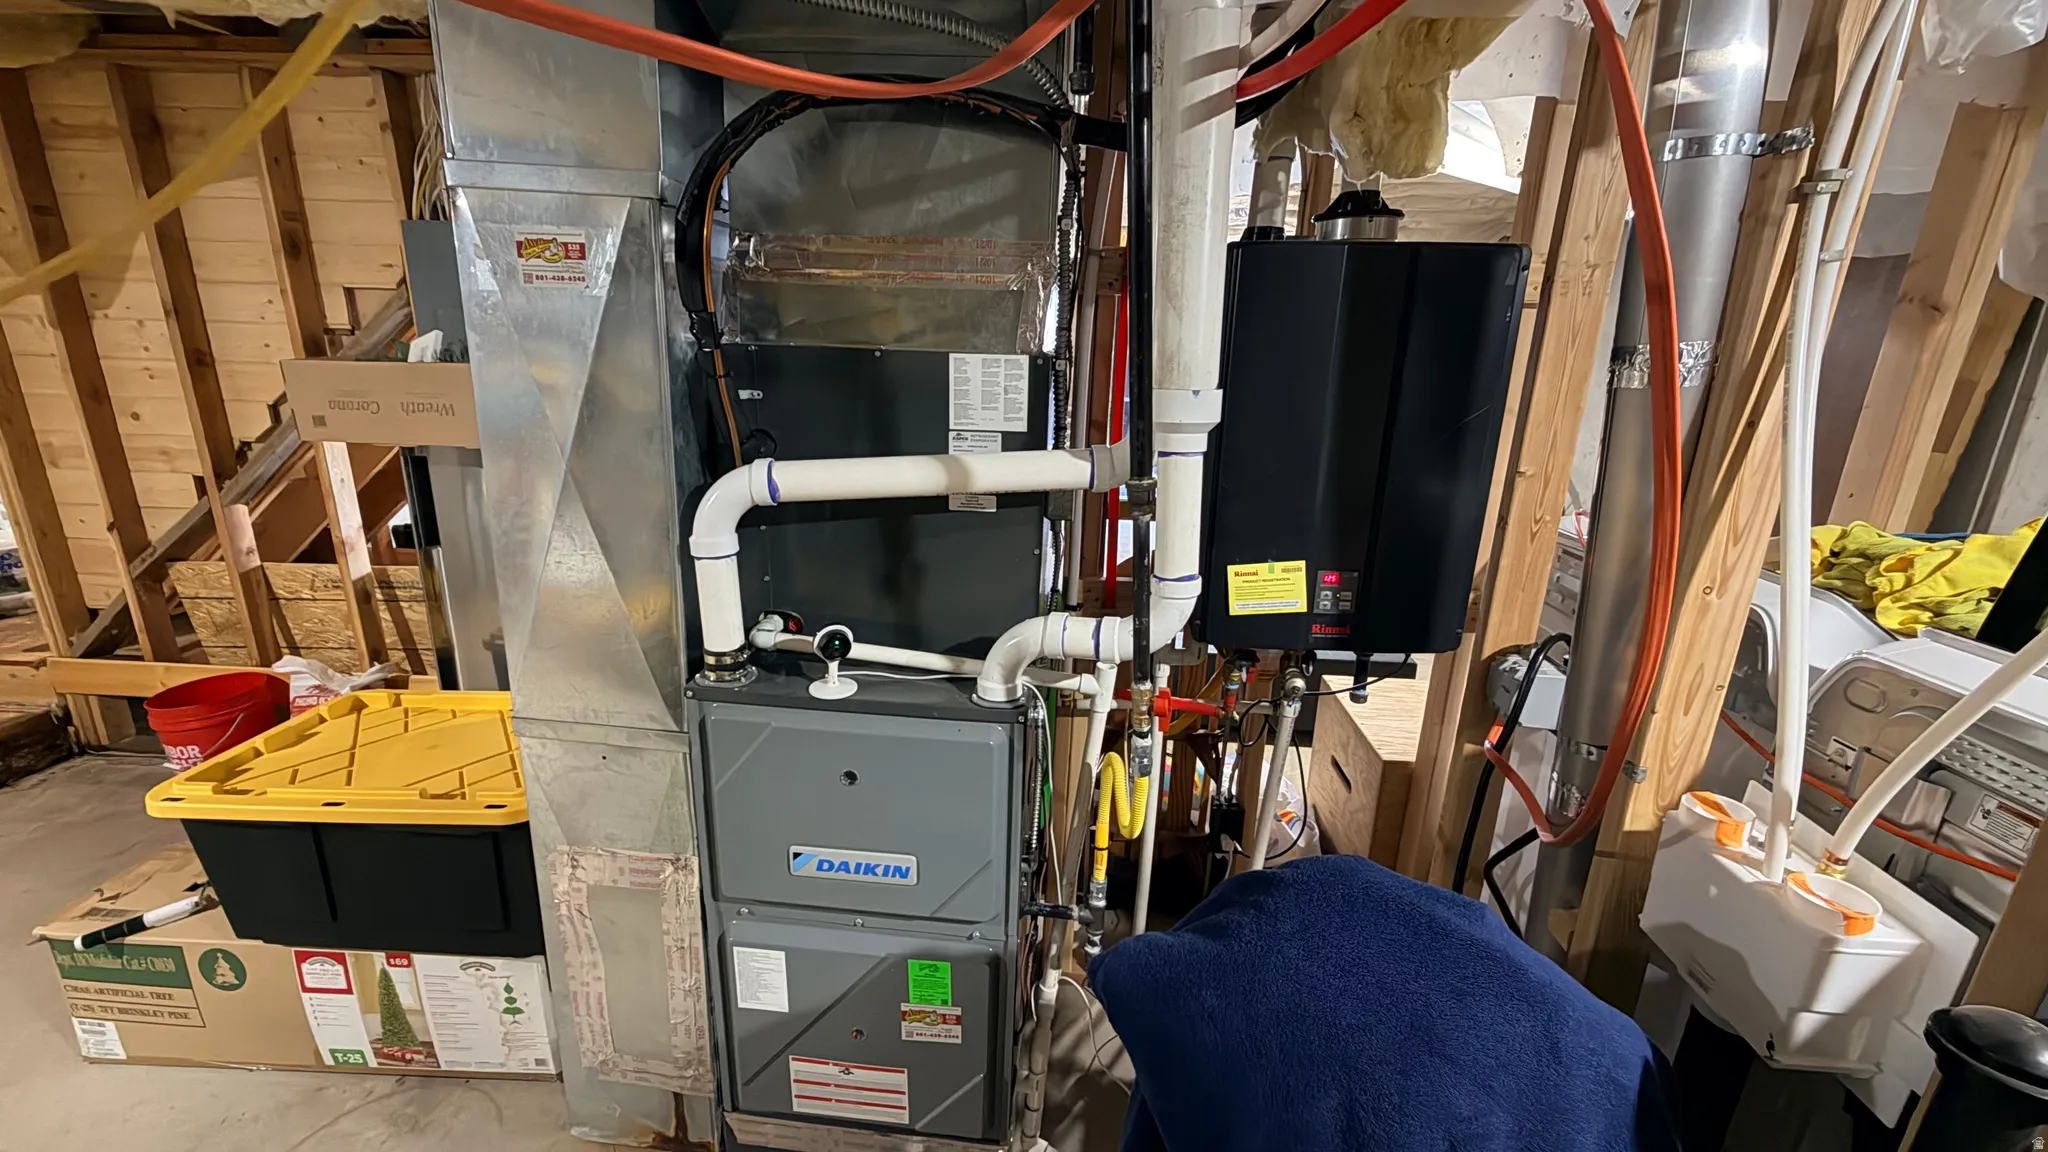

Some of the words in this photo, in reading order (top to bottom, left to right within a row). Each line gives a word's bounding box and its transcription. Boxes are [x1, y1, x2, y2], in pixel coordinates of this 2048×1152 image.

[328, 400, 380, 414] Corona
[400, 401, 455, 416] Wreath
[1311, 623, 1350, 634] Rinnai
[816, 858, 911, 879] DAIKIN
[93, 987, 149, 999] ARTIFICIAL
[150, 991, 176, 1001] TREE
[335, 1053, 364, 1064] T-25
